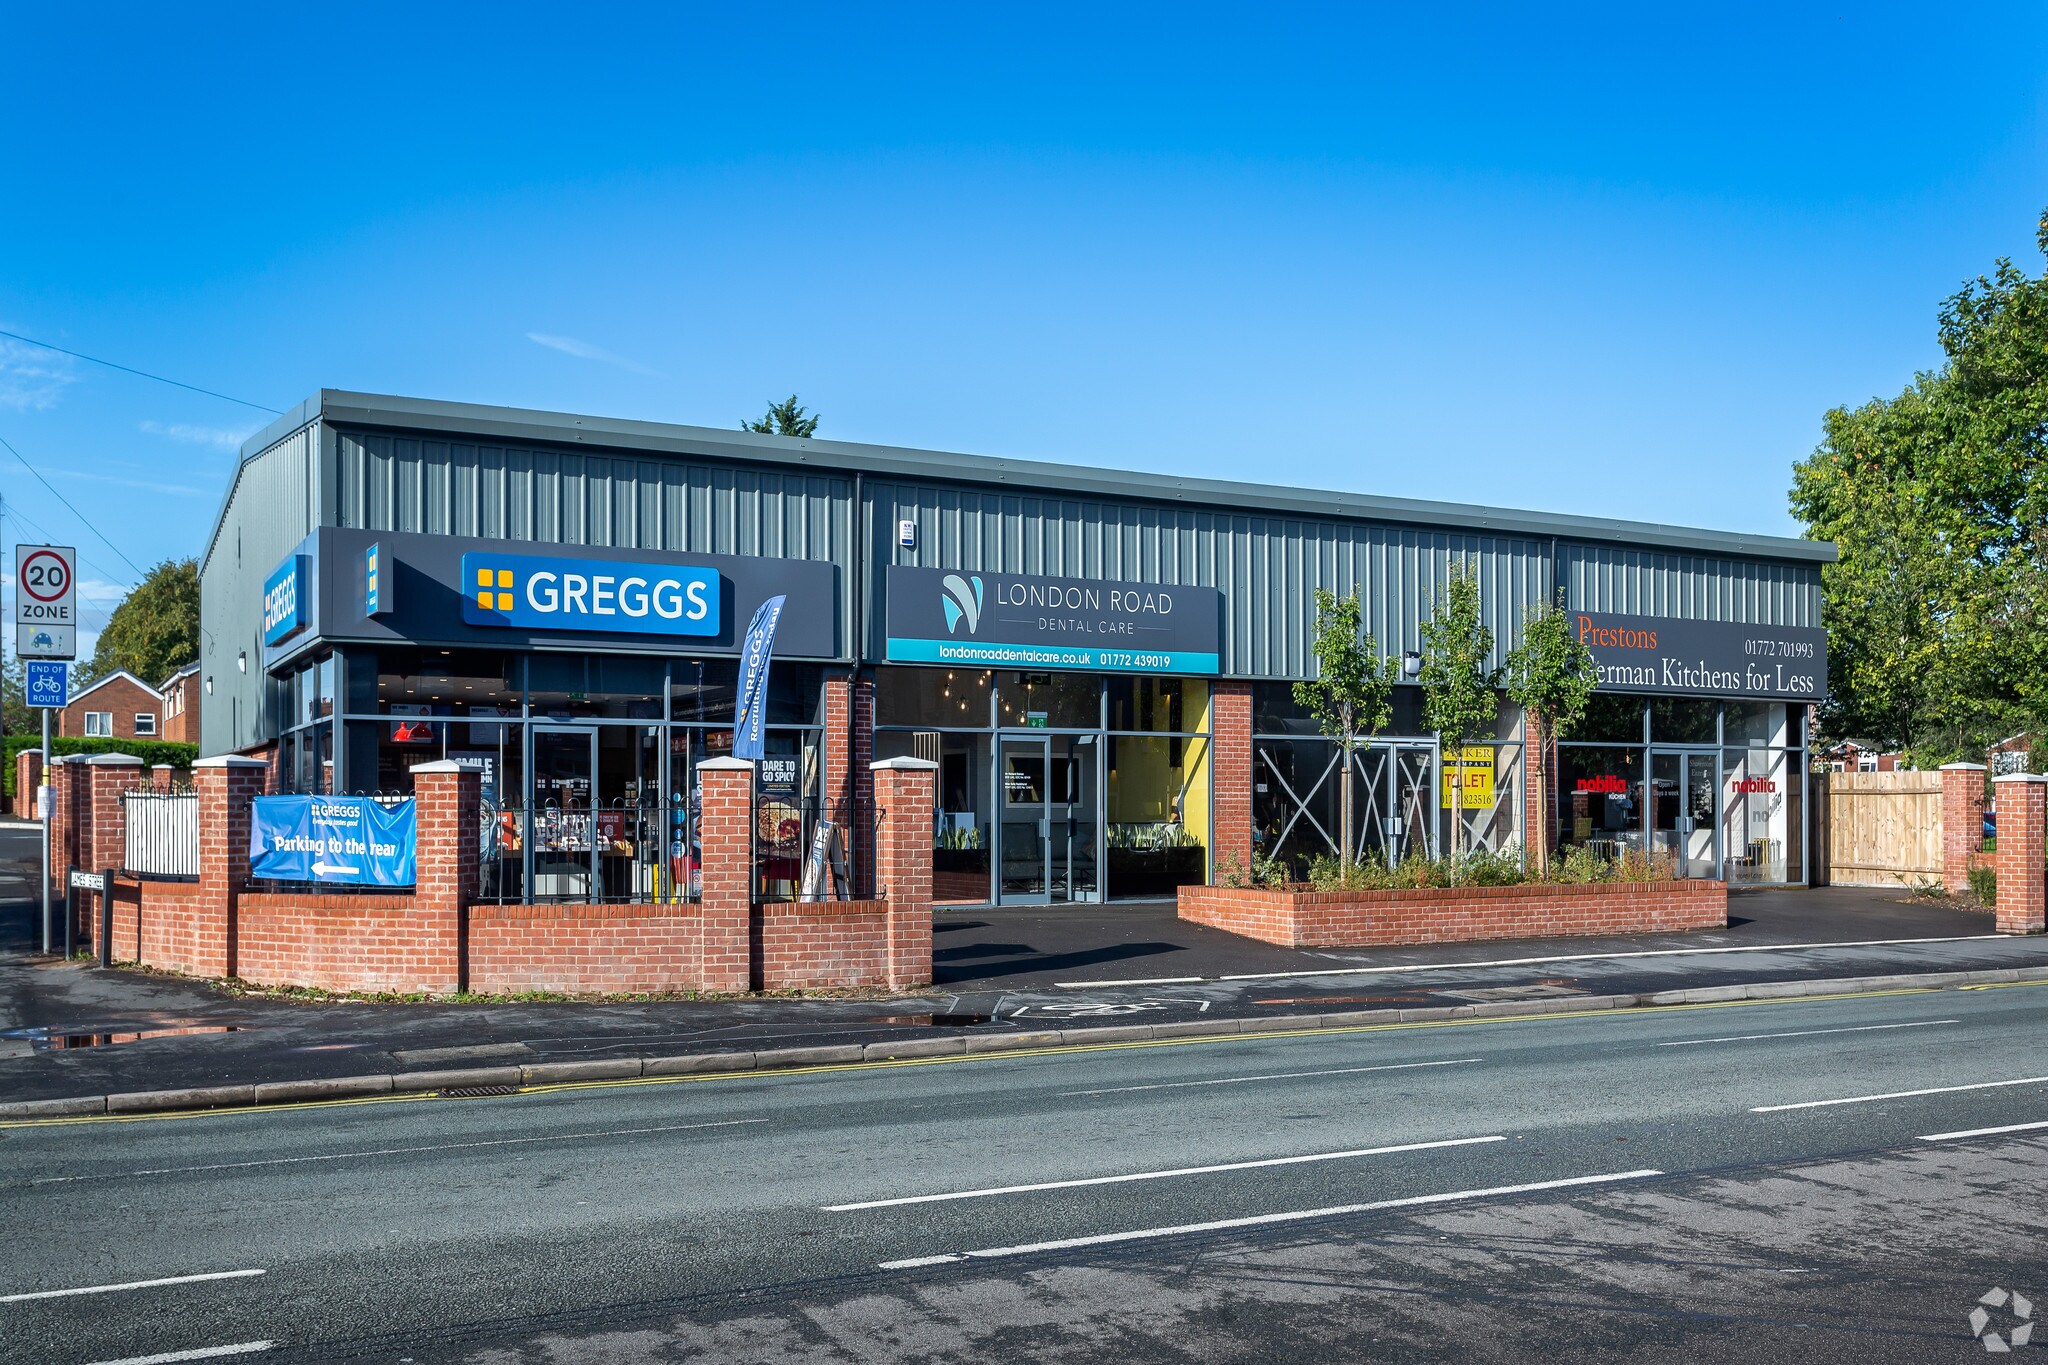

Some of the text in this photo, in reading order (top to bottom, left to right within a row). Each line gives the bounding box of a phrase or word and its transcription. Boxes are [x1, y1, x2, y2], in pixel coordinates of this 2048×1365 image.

[29, 565, 64, 587] 20
[270, 571, 296, 628] GREGGS
[526, 571, 708, 621] GREGGS
[997, 582, 1173, 615] LONDON ROAD
[23, 605, 69, 619] ZONE
[1038, 617, 1134, 635] DENTAL CARE
[1577, 615, 1658, 650] Prestons
[939, 645, 1171, 668] londonroaddentalcare.co.uk 01772 439019
[1744, 639, 1814, 659] 01772 701993
[31, 666, 64, 674] END OF
[744, 629, 764, 705] GREGGS
[1661, 657, 1741, 690] Kitchens
[1745, 662, 1771, 691] for
[1775, 664, 1814, 693] Less
[32, 695, 61, 703] ROUTE
[762, 760, 796, 772] DARE TO
[762, 771, 796, 782] GO SPICY
[1445, 773, 1487, 788] T LET
[1577, 775, 1627, 792] nobilia
[1658, 781, 1670, 789] Open
[1732, 776, 1776, 793] nobilia
[1464, 794, 1492, 805] 823516
[320, 804, 361, 818] GREGGS
[346, 819, 359, 827] good
[274, 835, 396, 857] Parking to the rear
